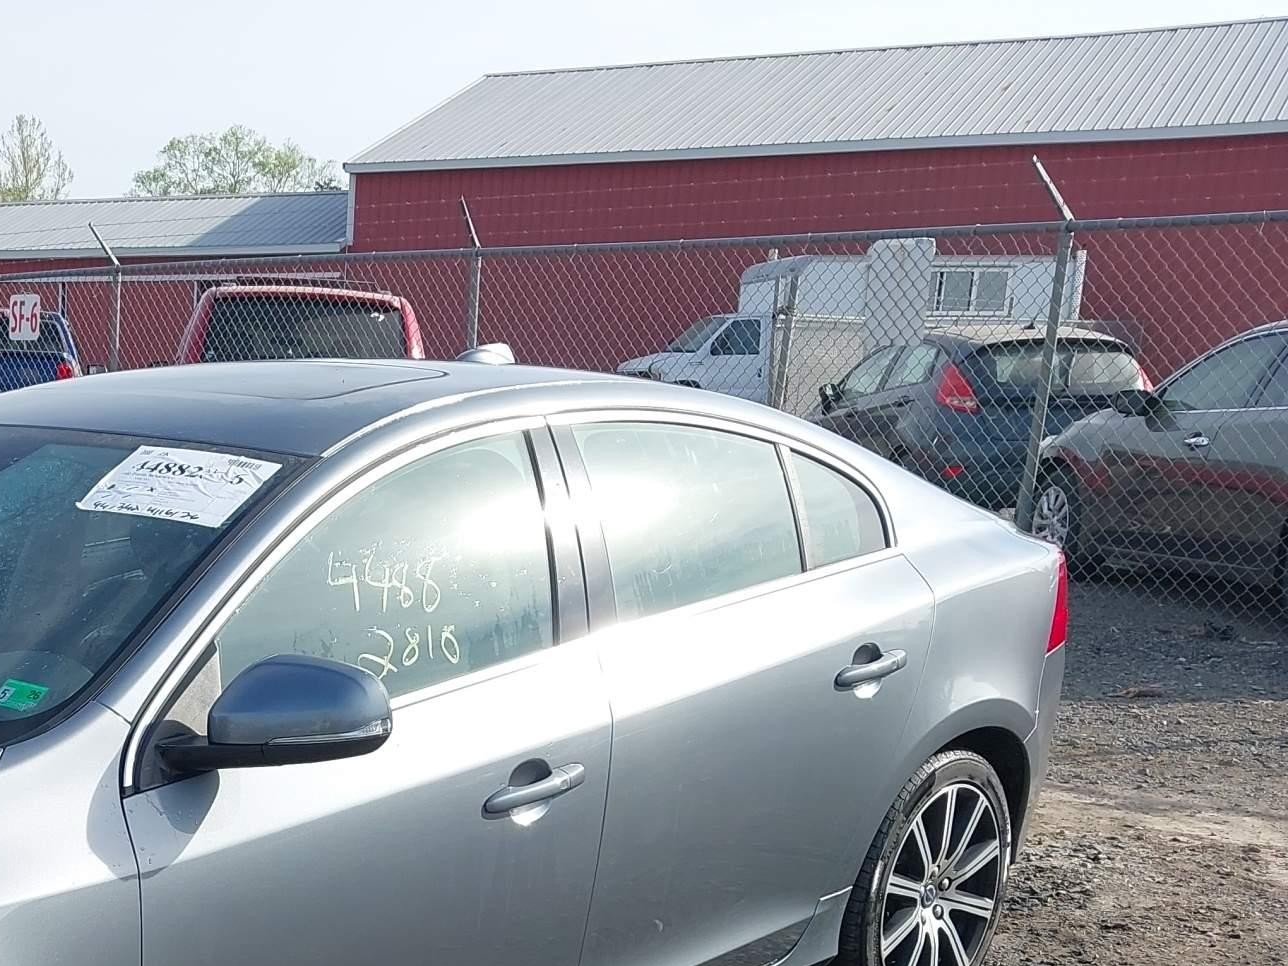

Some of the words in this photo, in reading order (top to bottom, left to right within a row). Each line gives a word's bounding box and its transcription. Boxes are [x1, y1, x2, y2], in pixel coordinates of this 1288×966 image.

[11, 300, 38, 333] SF-6
[327, 550, 441, 613] 4488
[26, 689, 42, 700] 26
